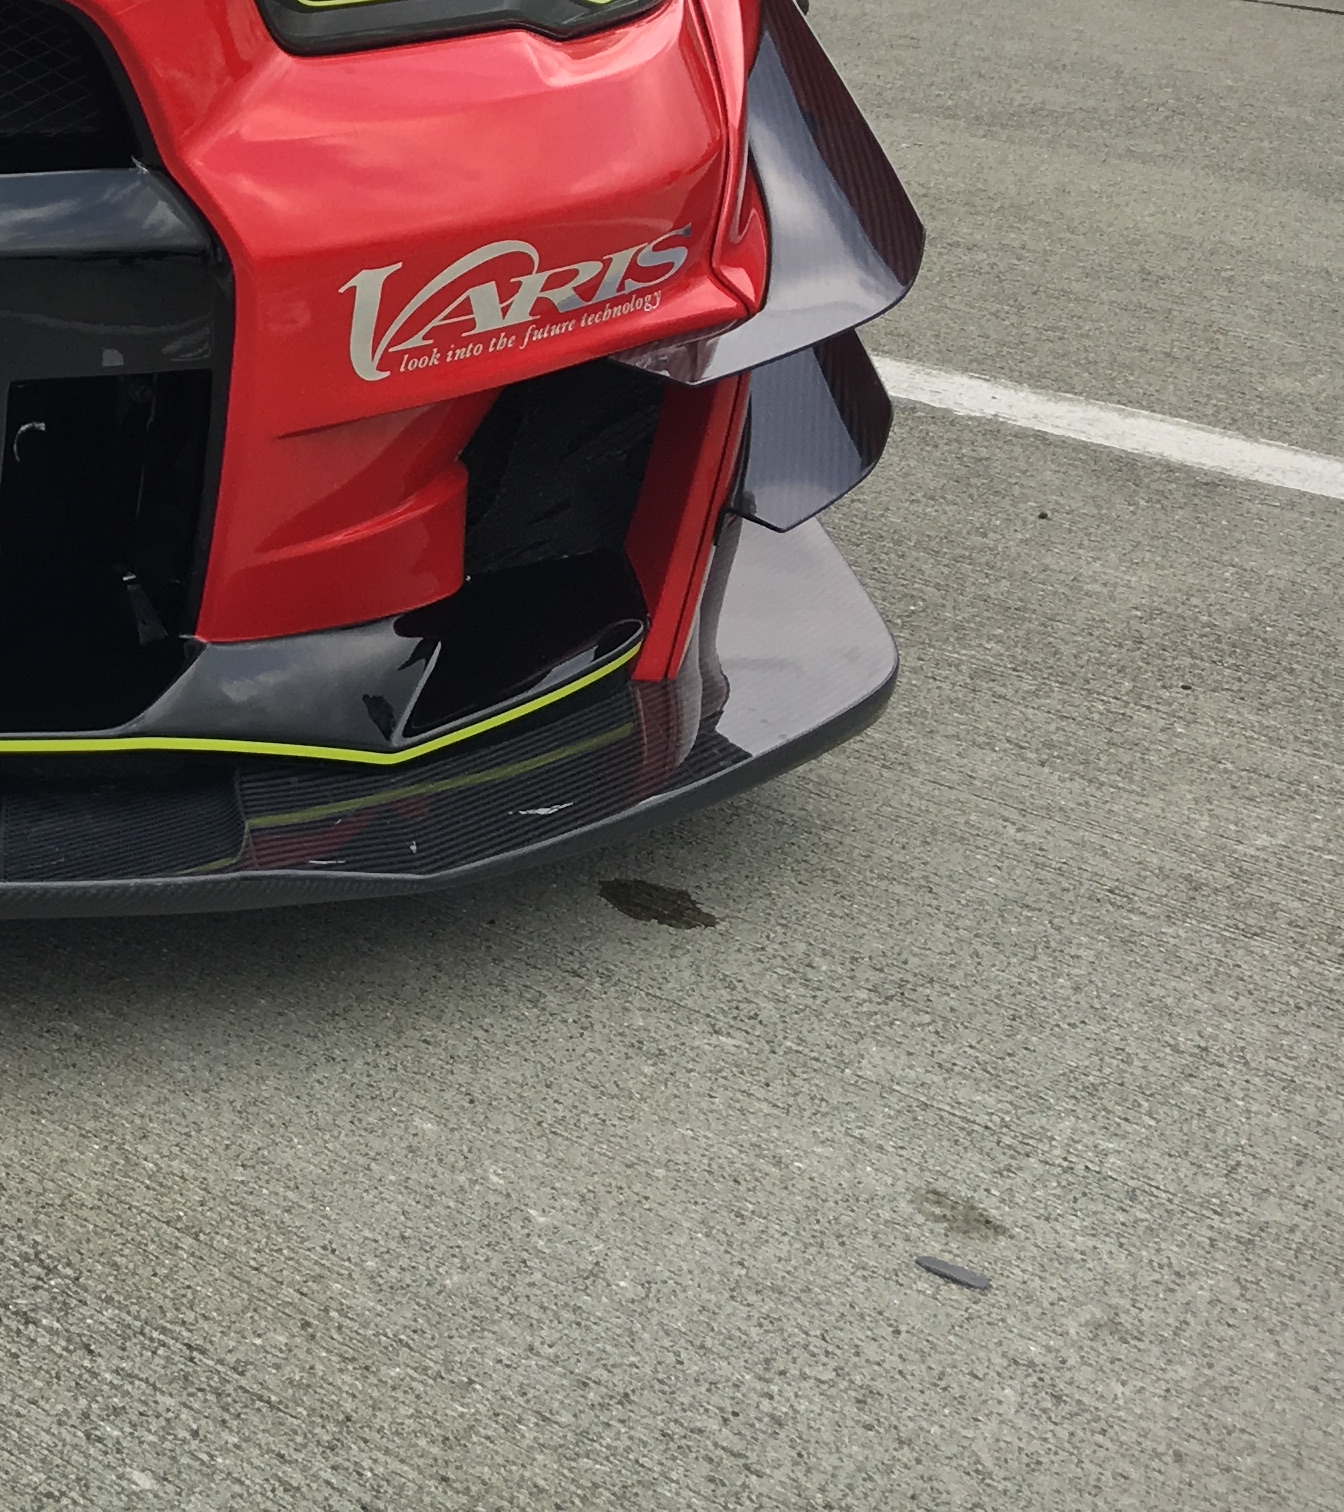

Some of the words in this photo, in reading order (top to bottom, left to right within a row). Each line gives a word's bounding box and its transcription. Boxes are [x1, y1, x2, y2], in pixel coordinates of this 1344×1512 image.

[338, 222, 692, 381] VARIS
[400, 352, 440, 373] look
[446, 343, 483, 363] into
[488, 333, 516, 352] the
[519, 318, 576, 349] future
[579, 290, 662, 327] technology
